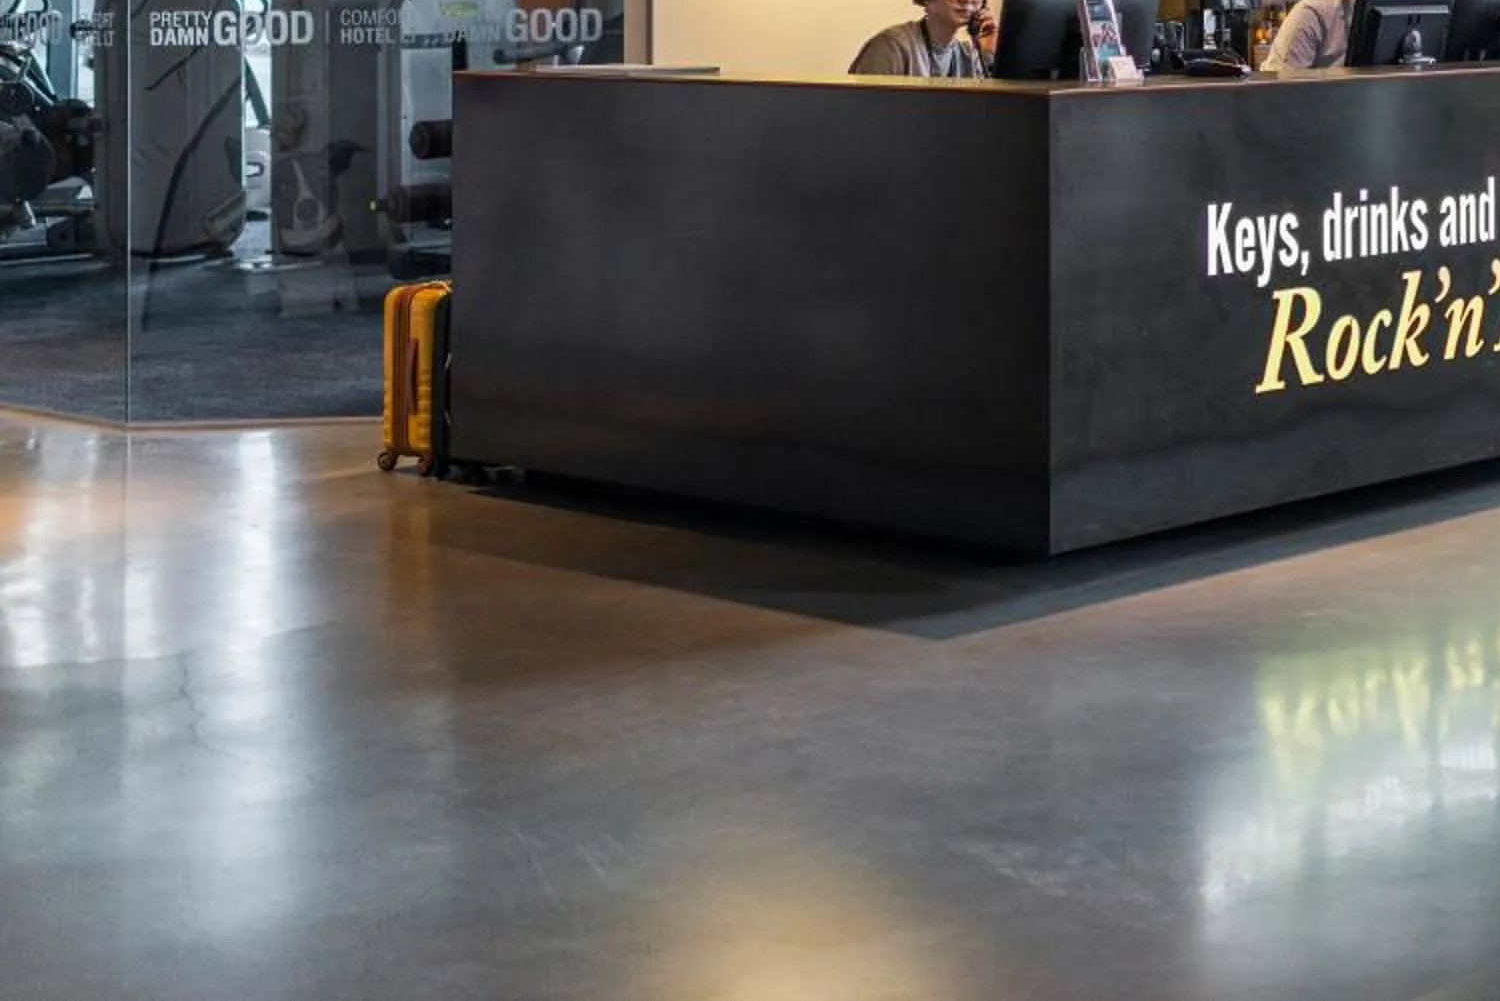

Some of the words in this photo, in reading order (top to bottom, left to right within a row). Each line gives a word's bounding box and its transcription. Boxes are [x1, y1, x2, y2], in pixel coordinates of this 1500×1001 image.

[151, 11, 213, 28] PRETTY
[151, 28, 208, 46] DAMN
[213, 10, 314, 46] GOOD
[340, 9, 400, 27] COMFO
[504, 7, 602, 43] GOOD
[340, 27, 395, 44] HOTEL
[1207, 202, 1310, 287] Keys,
[1322, 186, 1429, 261] drinks
[1439, 176, 1496, 248] and
